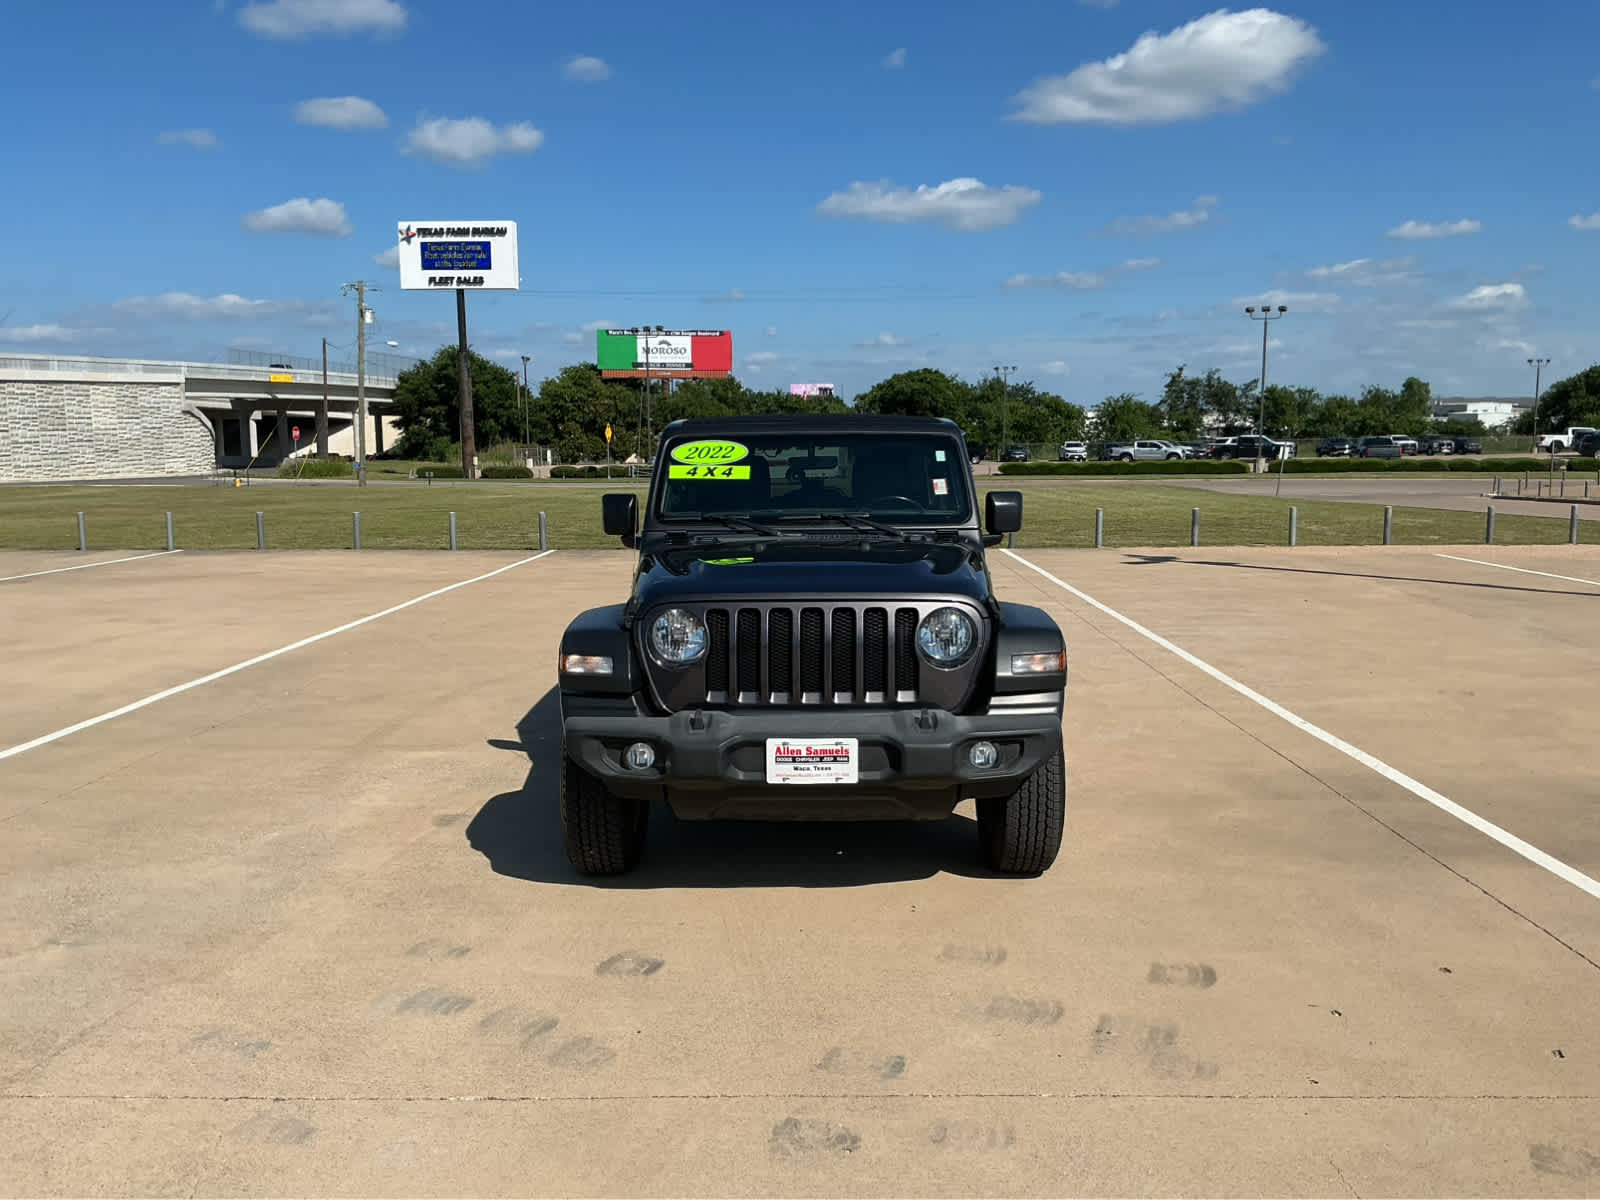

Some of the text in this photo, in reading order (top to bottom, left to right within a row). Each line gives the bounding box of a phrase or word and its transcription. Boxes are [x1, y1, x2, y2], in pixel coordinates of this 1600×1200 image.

[416, 226, 508, 238] TEXAS FARM BUREAU
[428, 276, 485, 286] FLEET SALES
[642, 346, 687, 355] MOROSO
[683, 446, 735, 459] 2022
[775, 746, 850, 756] Allen Samuels
